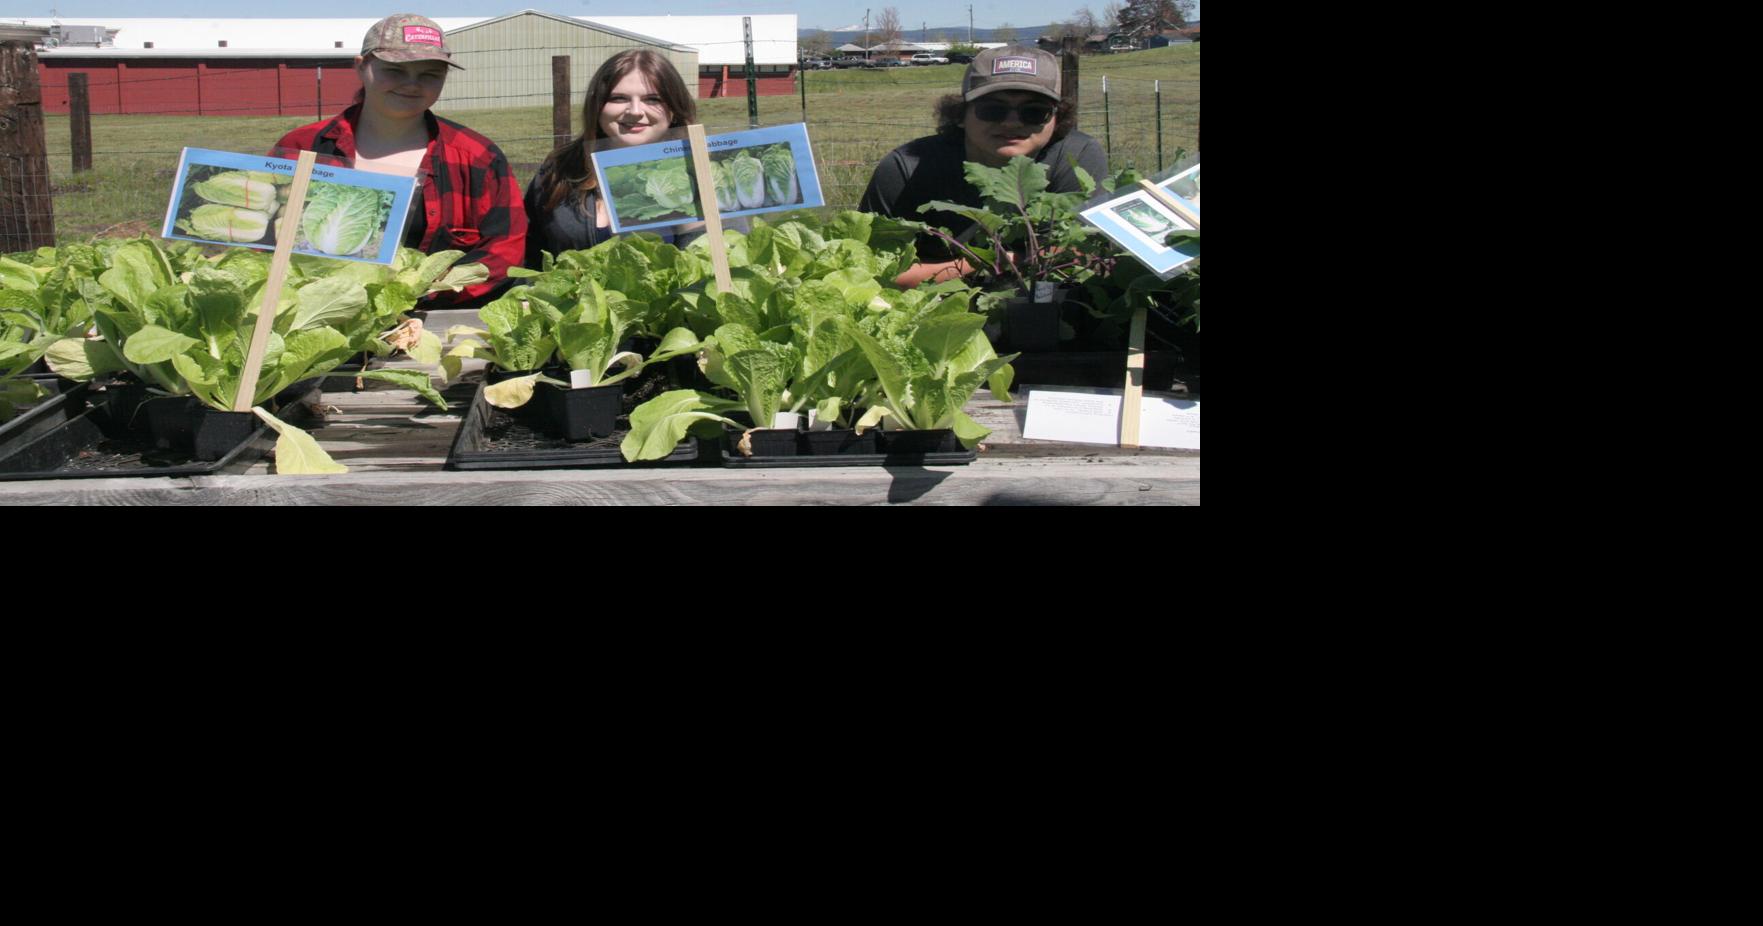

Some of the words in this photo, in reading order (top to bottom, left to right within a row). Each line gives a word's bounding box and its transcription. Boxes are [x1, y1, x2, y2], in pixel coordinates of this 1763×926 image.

[999, 60, 1032, 69] AMERICA
[707, 138, 738, 148] abbage
[265, 161, 292, 171] Kyota
[311, 168, 334, 177] bage
